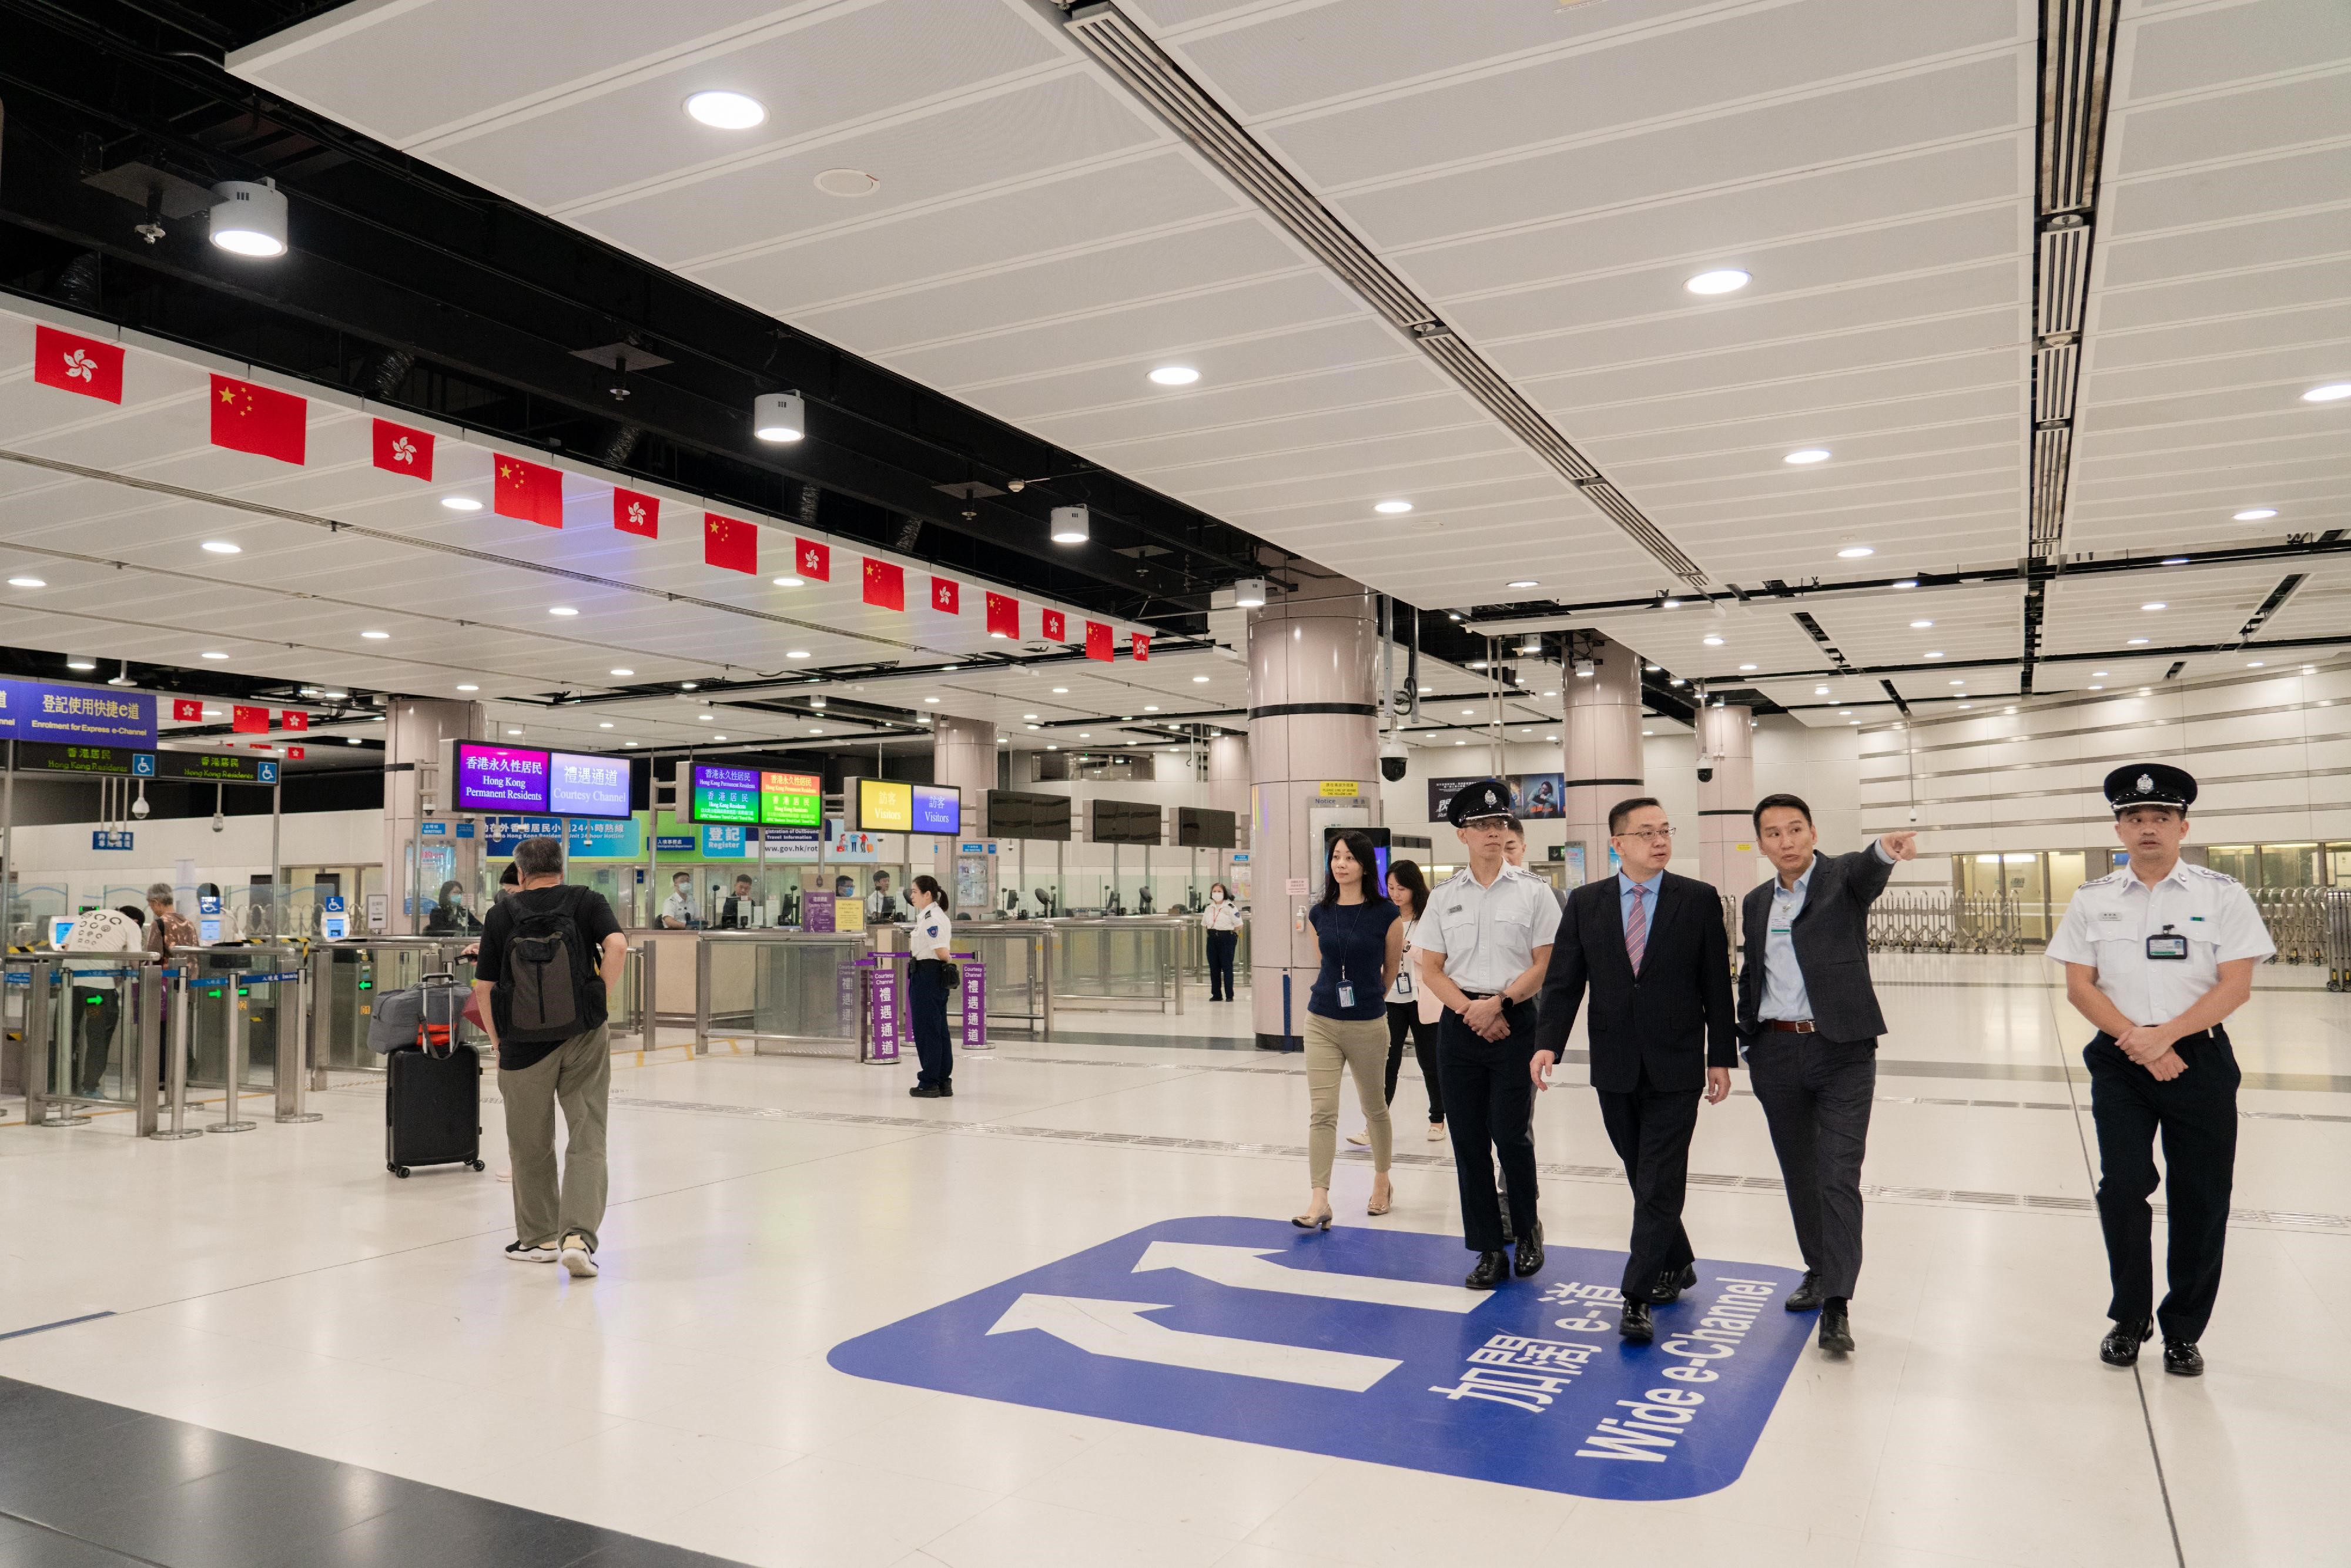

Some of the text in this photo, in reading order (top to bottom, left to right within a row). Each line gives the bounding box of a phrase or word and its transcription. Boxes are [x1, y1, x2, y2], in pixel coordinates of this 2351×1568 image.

[42, 694, 140, 720] 登記使用快捷e道
[32, 720, 69, 731] Enrolment
[82, 725, 110, 733] Express
[112, 727, 147, 736] e-Channel
[67, 747, 111, 760] 香港居民
[48, 760, 69, 769] Hong
[71, 760, 91, 770] Kong
[466, 756, 542, 775] 香港永久性居民
[185, 769, 203, 778] Hong
[203, 770, 222, 779] Kong
[564, 765, 618, 786] 禮遇通道
[705, 769, 751, 782] 香港永久性居民
[771, 775, 812, 787] 香港永久性居民
[483, 775, 526, 789] Hong Kong
[466, 786, 542, 801] Permanent Residents
[553, 788, 627, 803] Courtesy Channel
[707, 790, 748, 802] 香港居民
[879, 791, 896, 806] 訪客
[929, 796, 945, 809] 訪客
[875, 808, 901, 820] Visitors
[925, 811, 949, 823] Visitors
[709, 827, 740, 842] 登記
[708, 842, 740, 850] Register
[765, 845, 818, 853] ww.gov.hk/rot
[967, 980, 979, 1042] 禮遇通道
[879, 987, 894, 1055] 禮遇通道
[1575, 1277, 1778, 1463] Wide e-Channel
